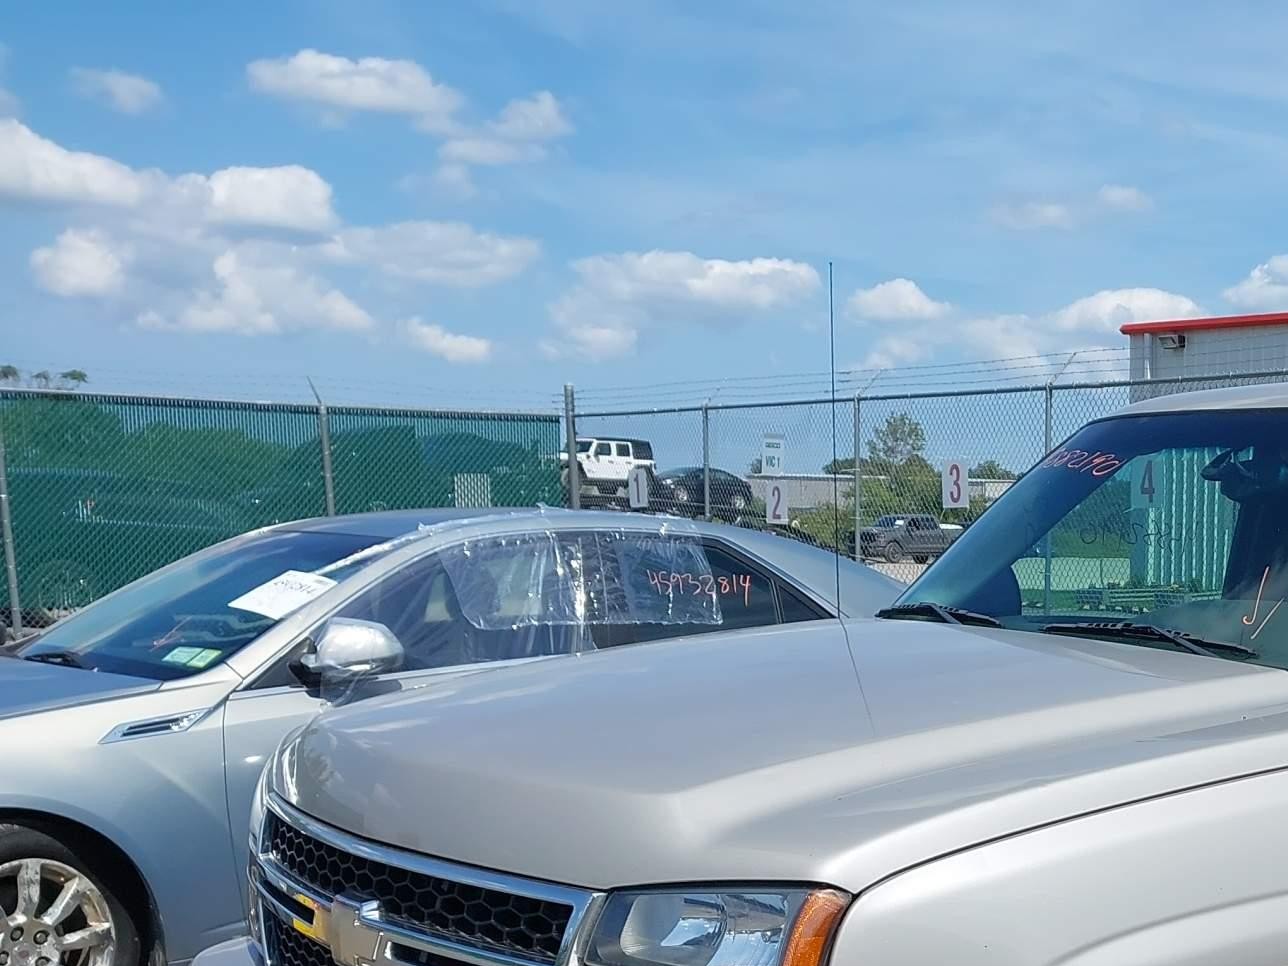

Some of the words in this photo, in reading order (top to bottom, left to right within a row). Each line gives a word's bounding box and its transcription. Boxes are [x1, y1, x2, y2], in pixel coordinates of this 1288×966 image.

[633, 473, 642, 504] 1
[949, 463, 962, 504] 3
[1140, 460, 1156, 503] 4
[771, 485, 782, 520] 2
[647, 569, 751, 608] 45932814
